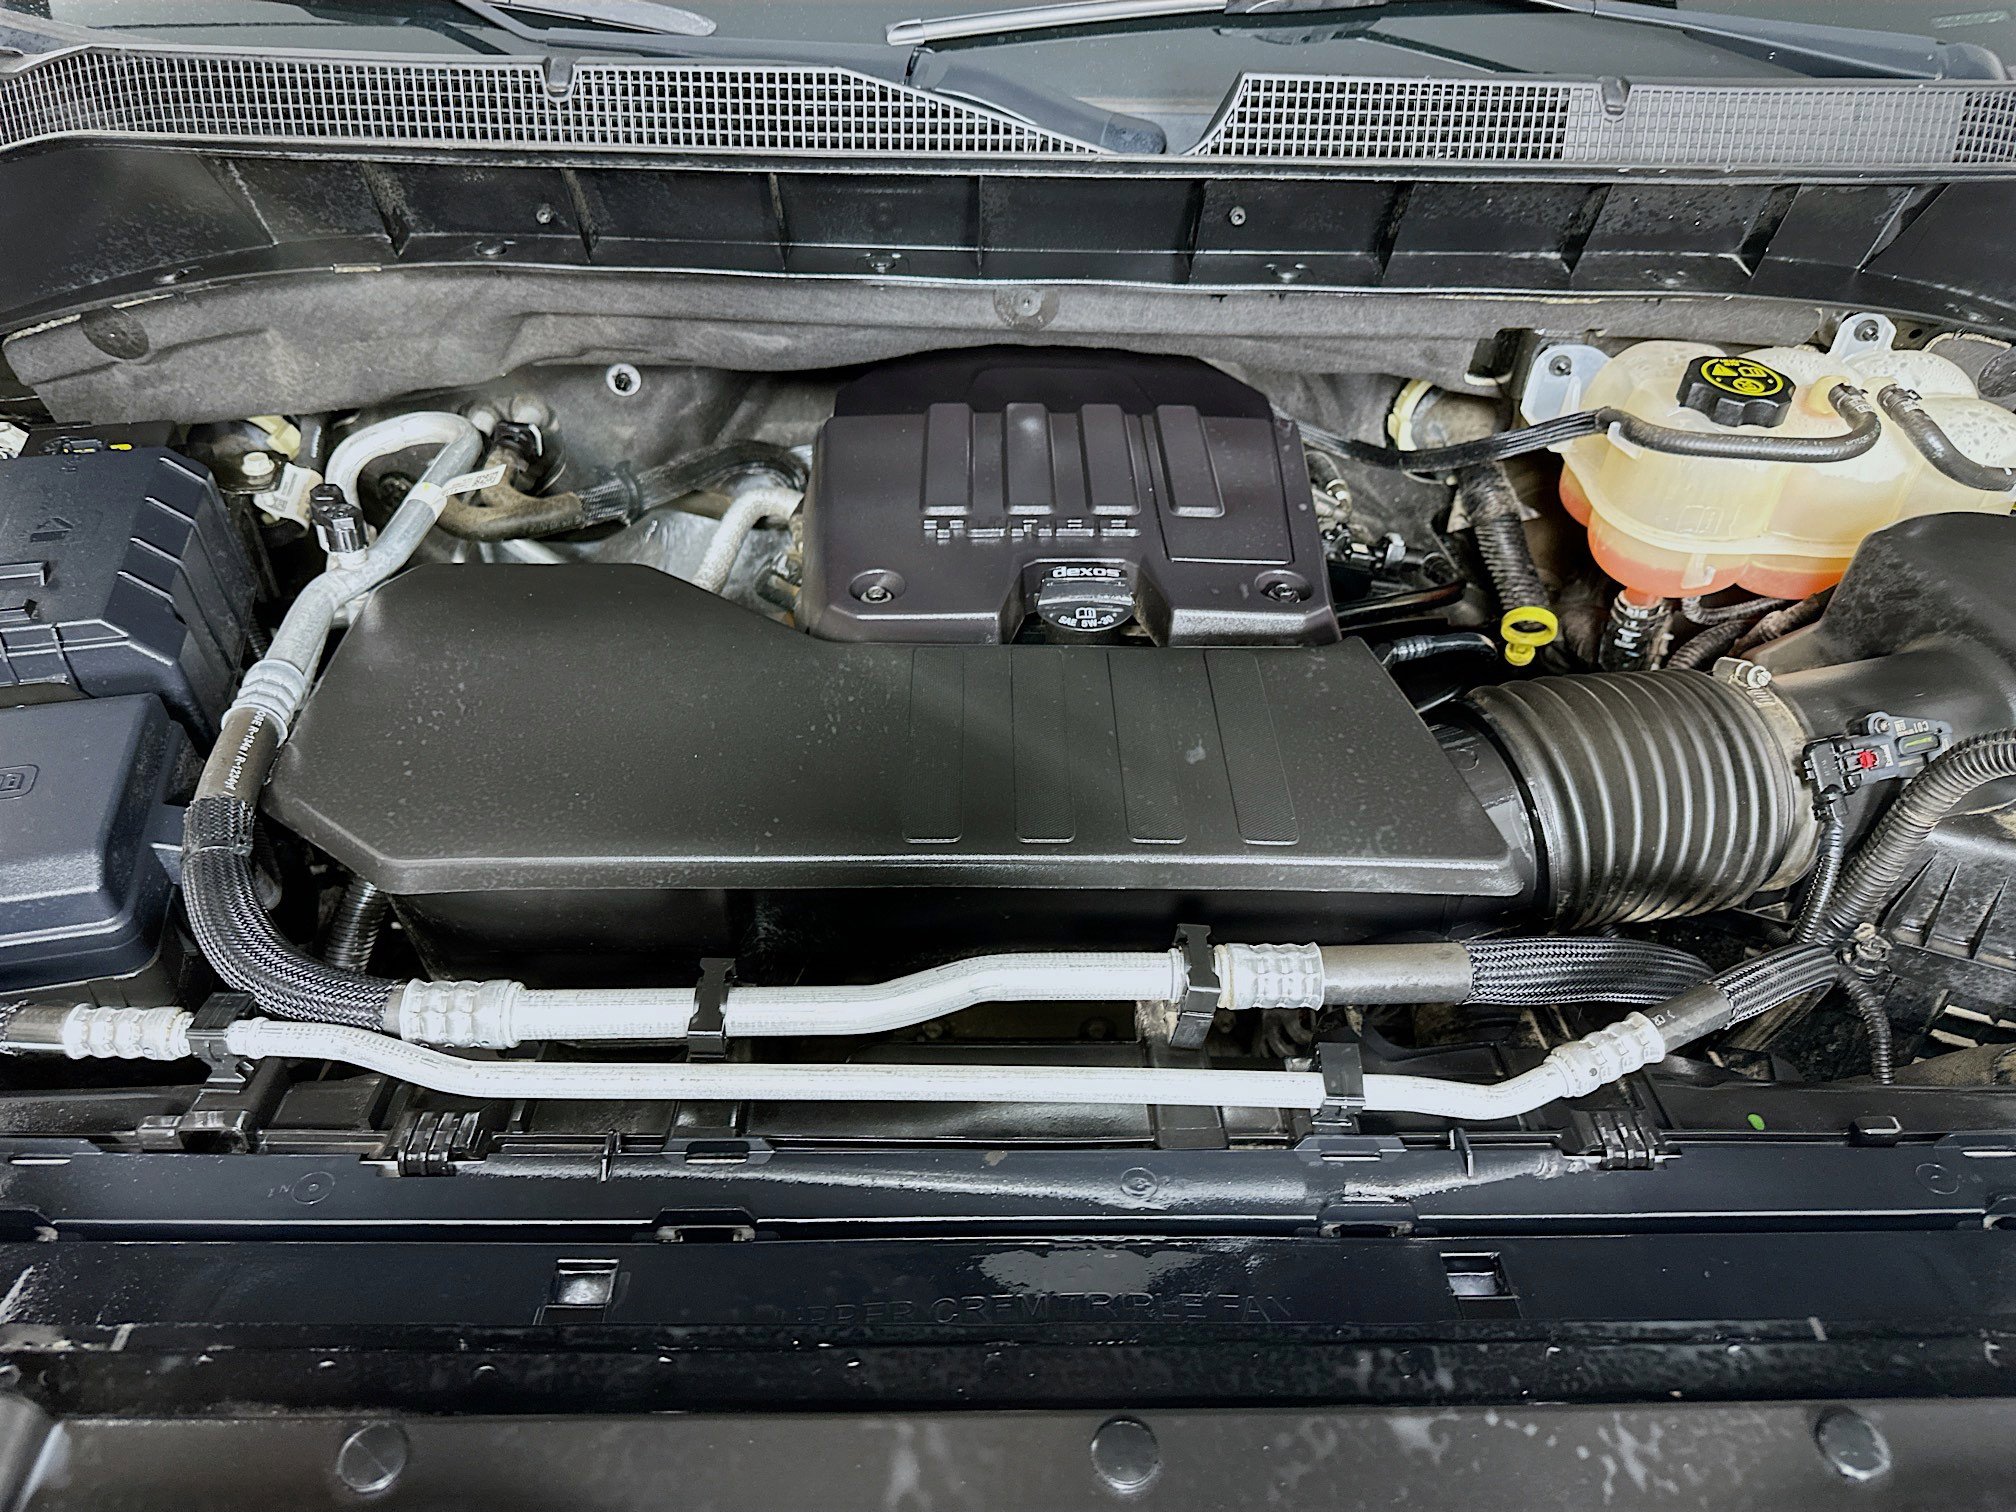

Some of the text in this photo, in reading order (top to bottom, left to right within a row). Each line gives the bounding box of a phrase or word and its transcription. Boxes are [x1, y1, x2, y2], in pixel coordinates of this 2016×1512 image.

[1053, 566, 1121, 578] dexos
[1058, 615, 1114, 628] SAE 5W-30
[251, 711, 267, 726] OSE
[240, 726, 260, 751] R-134a
